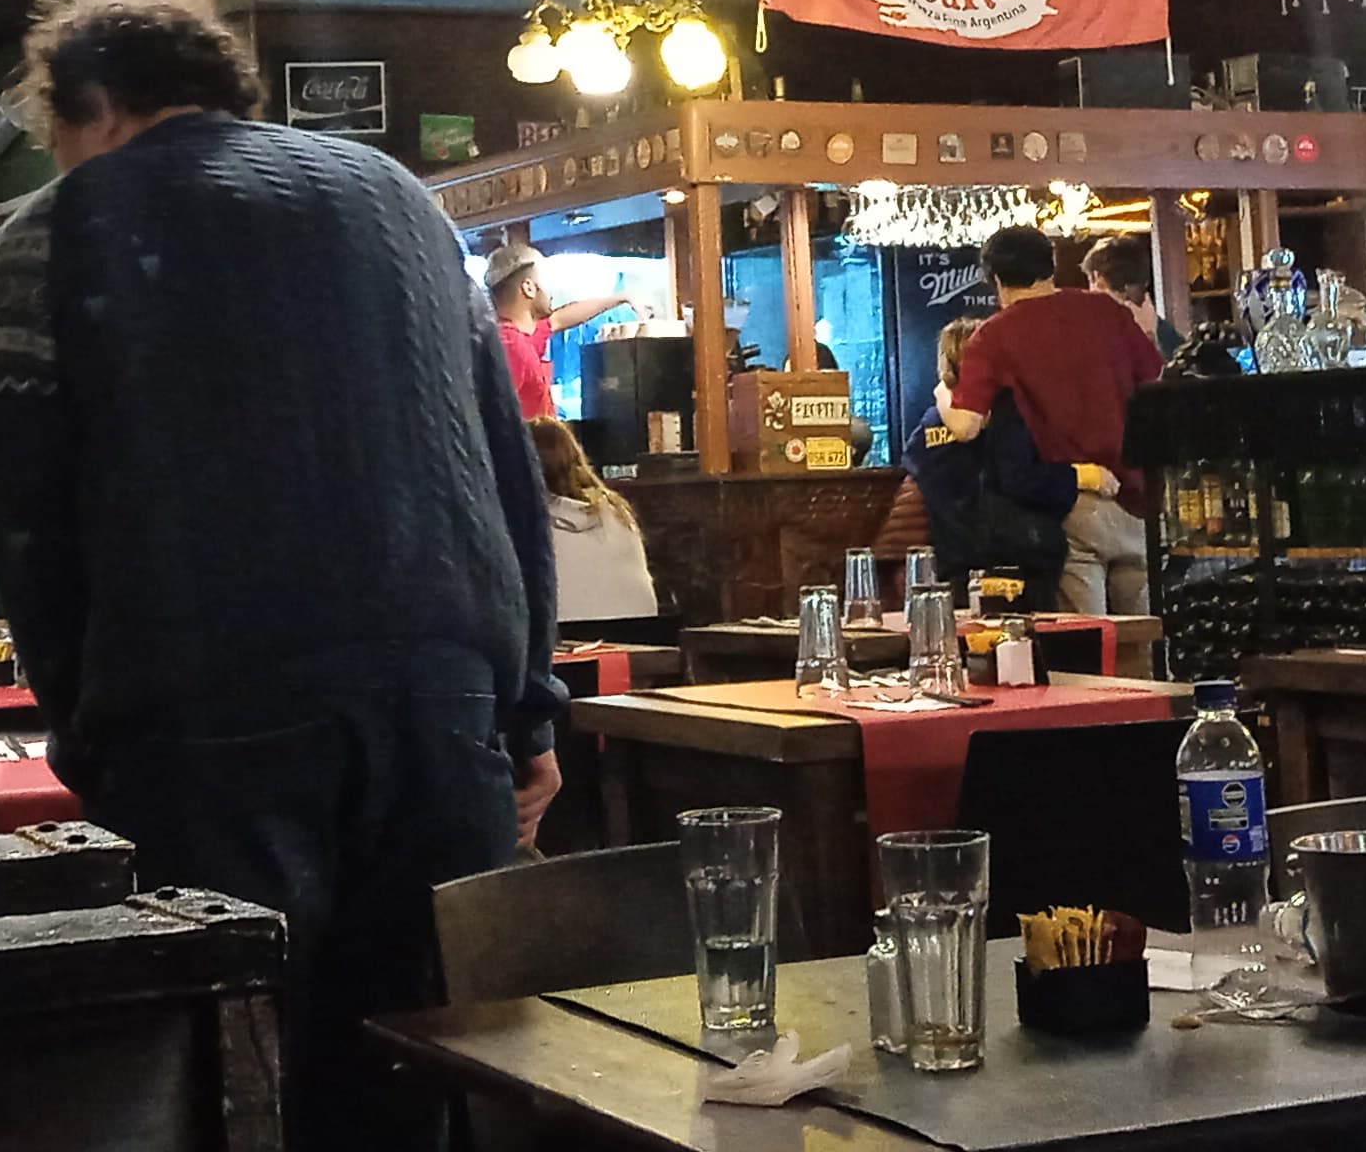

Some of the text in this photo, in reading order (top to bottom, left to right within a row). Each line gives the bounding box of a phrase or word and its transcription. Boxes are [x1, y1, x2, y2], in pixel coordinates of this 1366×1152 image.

[970, 3, 1027, 29] Argentina
[919, 264, 987, 307] Mille
[963, 295, 997, 306] TIME
